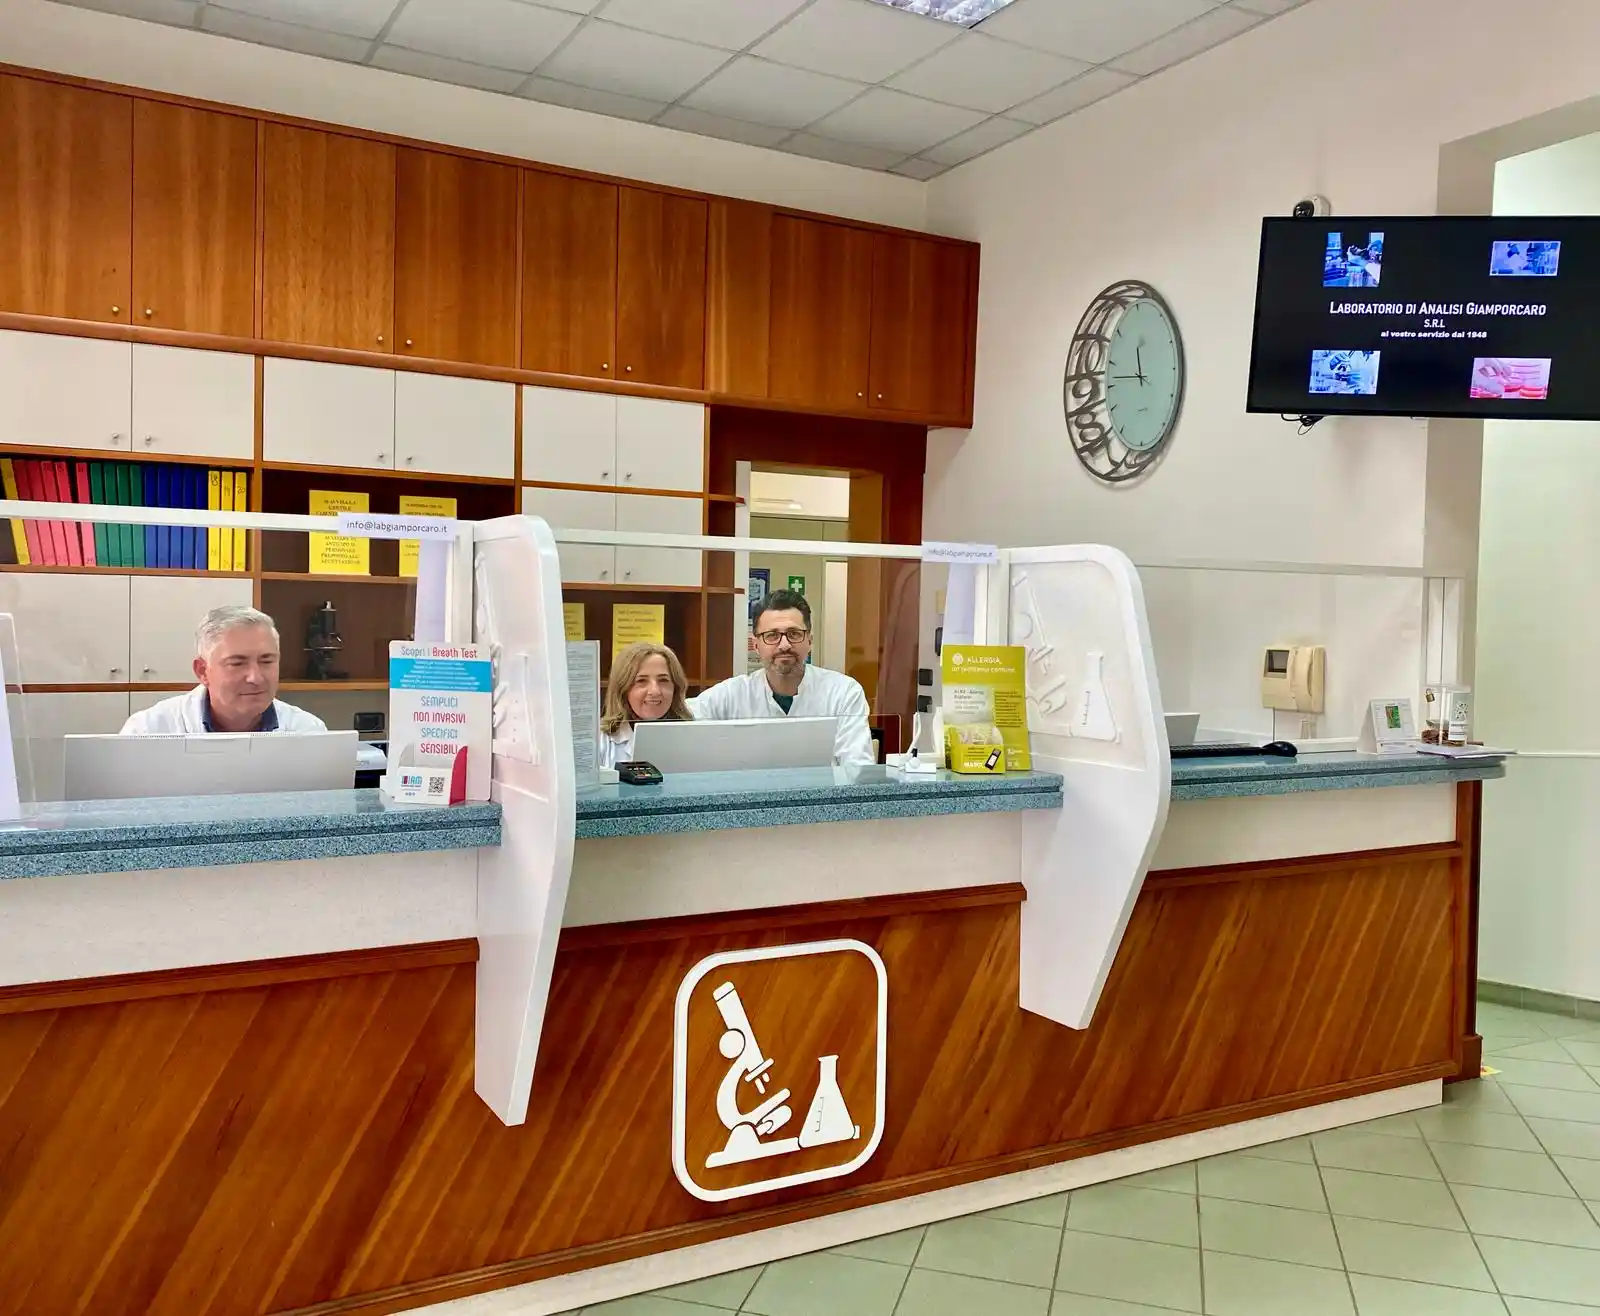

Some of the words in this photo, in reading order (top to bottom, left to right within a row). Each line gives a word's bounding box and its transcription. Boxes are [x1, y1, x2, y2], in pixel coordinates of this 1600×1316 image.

[1329, 301, 1403, 315] LABORATORIO
[1405, 303, 1417, 315] DI
[1418, 302, 1463, 315] ANALISI
[1465, 302, 1547, 316] GIAMPORCARO
[346, 521, 447, 533] info@labgiamporcaro.it
[400, 646, 424, 657] Scopri
[432, 647, 459, 657] Breath
[461, 648, 477, 658] Test
[420, 695, 458, 708] SEMPLICI
[413, 711, 430, 722] NON
[432, 712, 466, 724] INVASIVI
[421, 727, 458, 739] SPECIFICI
[420, 742, 458, 755] SENSIBILI
